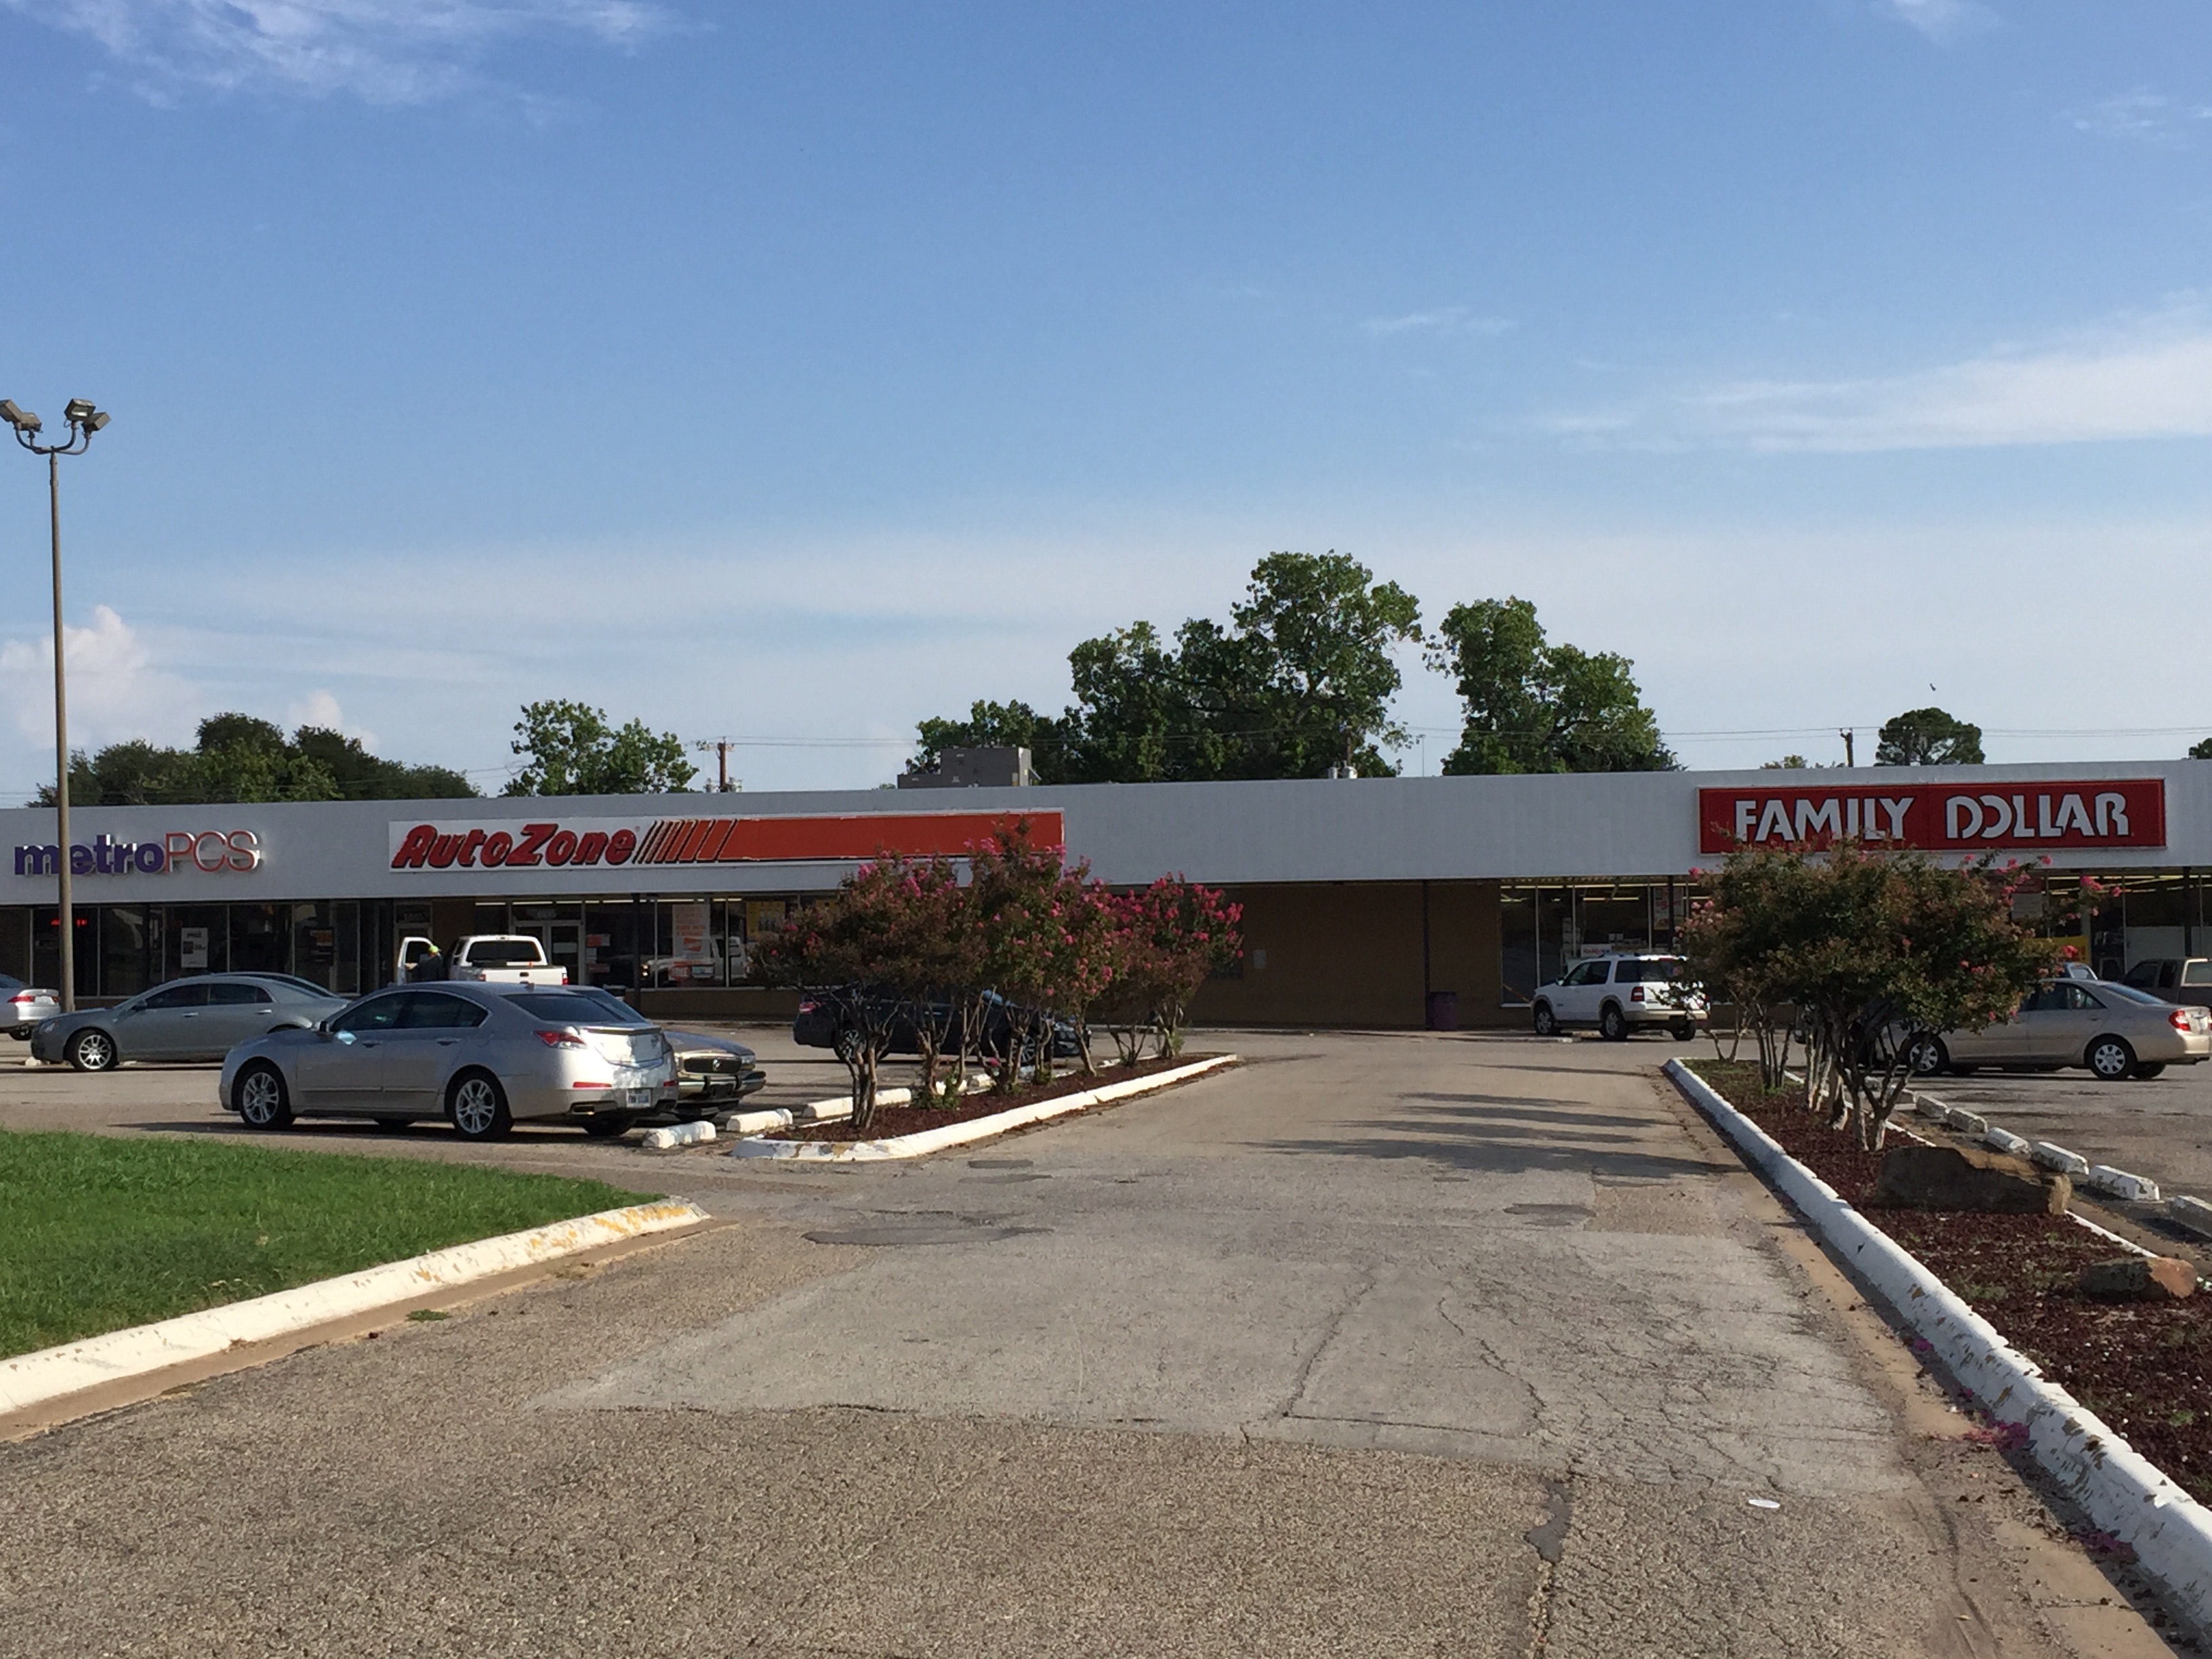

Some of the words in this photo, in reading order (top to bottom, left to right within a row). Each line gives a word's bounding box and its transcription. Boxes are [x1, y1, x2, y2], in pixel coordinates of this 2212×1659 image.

[1734, 796, 1916, 842] FAMILY
[1944, 792, 2130, 840] DOLLAR
[14, 830, 260, 875] metroPCS
[391, 823, 638, 868] AutoZone
